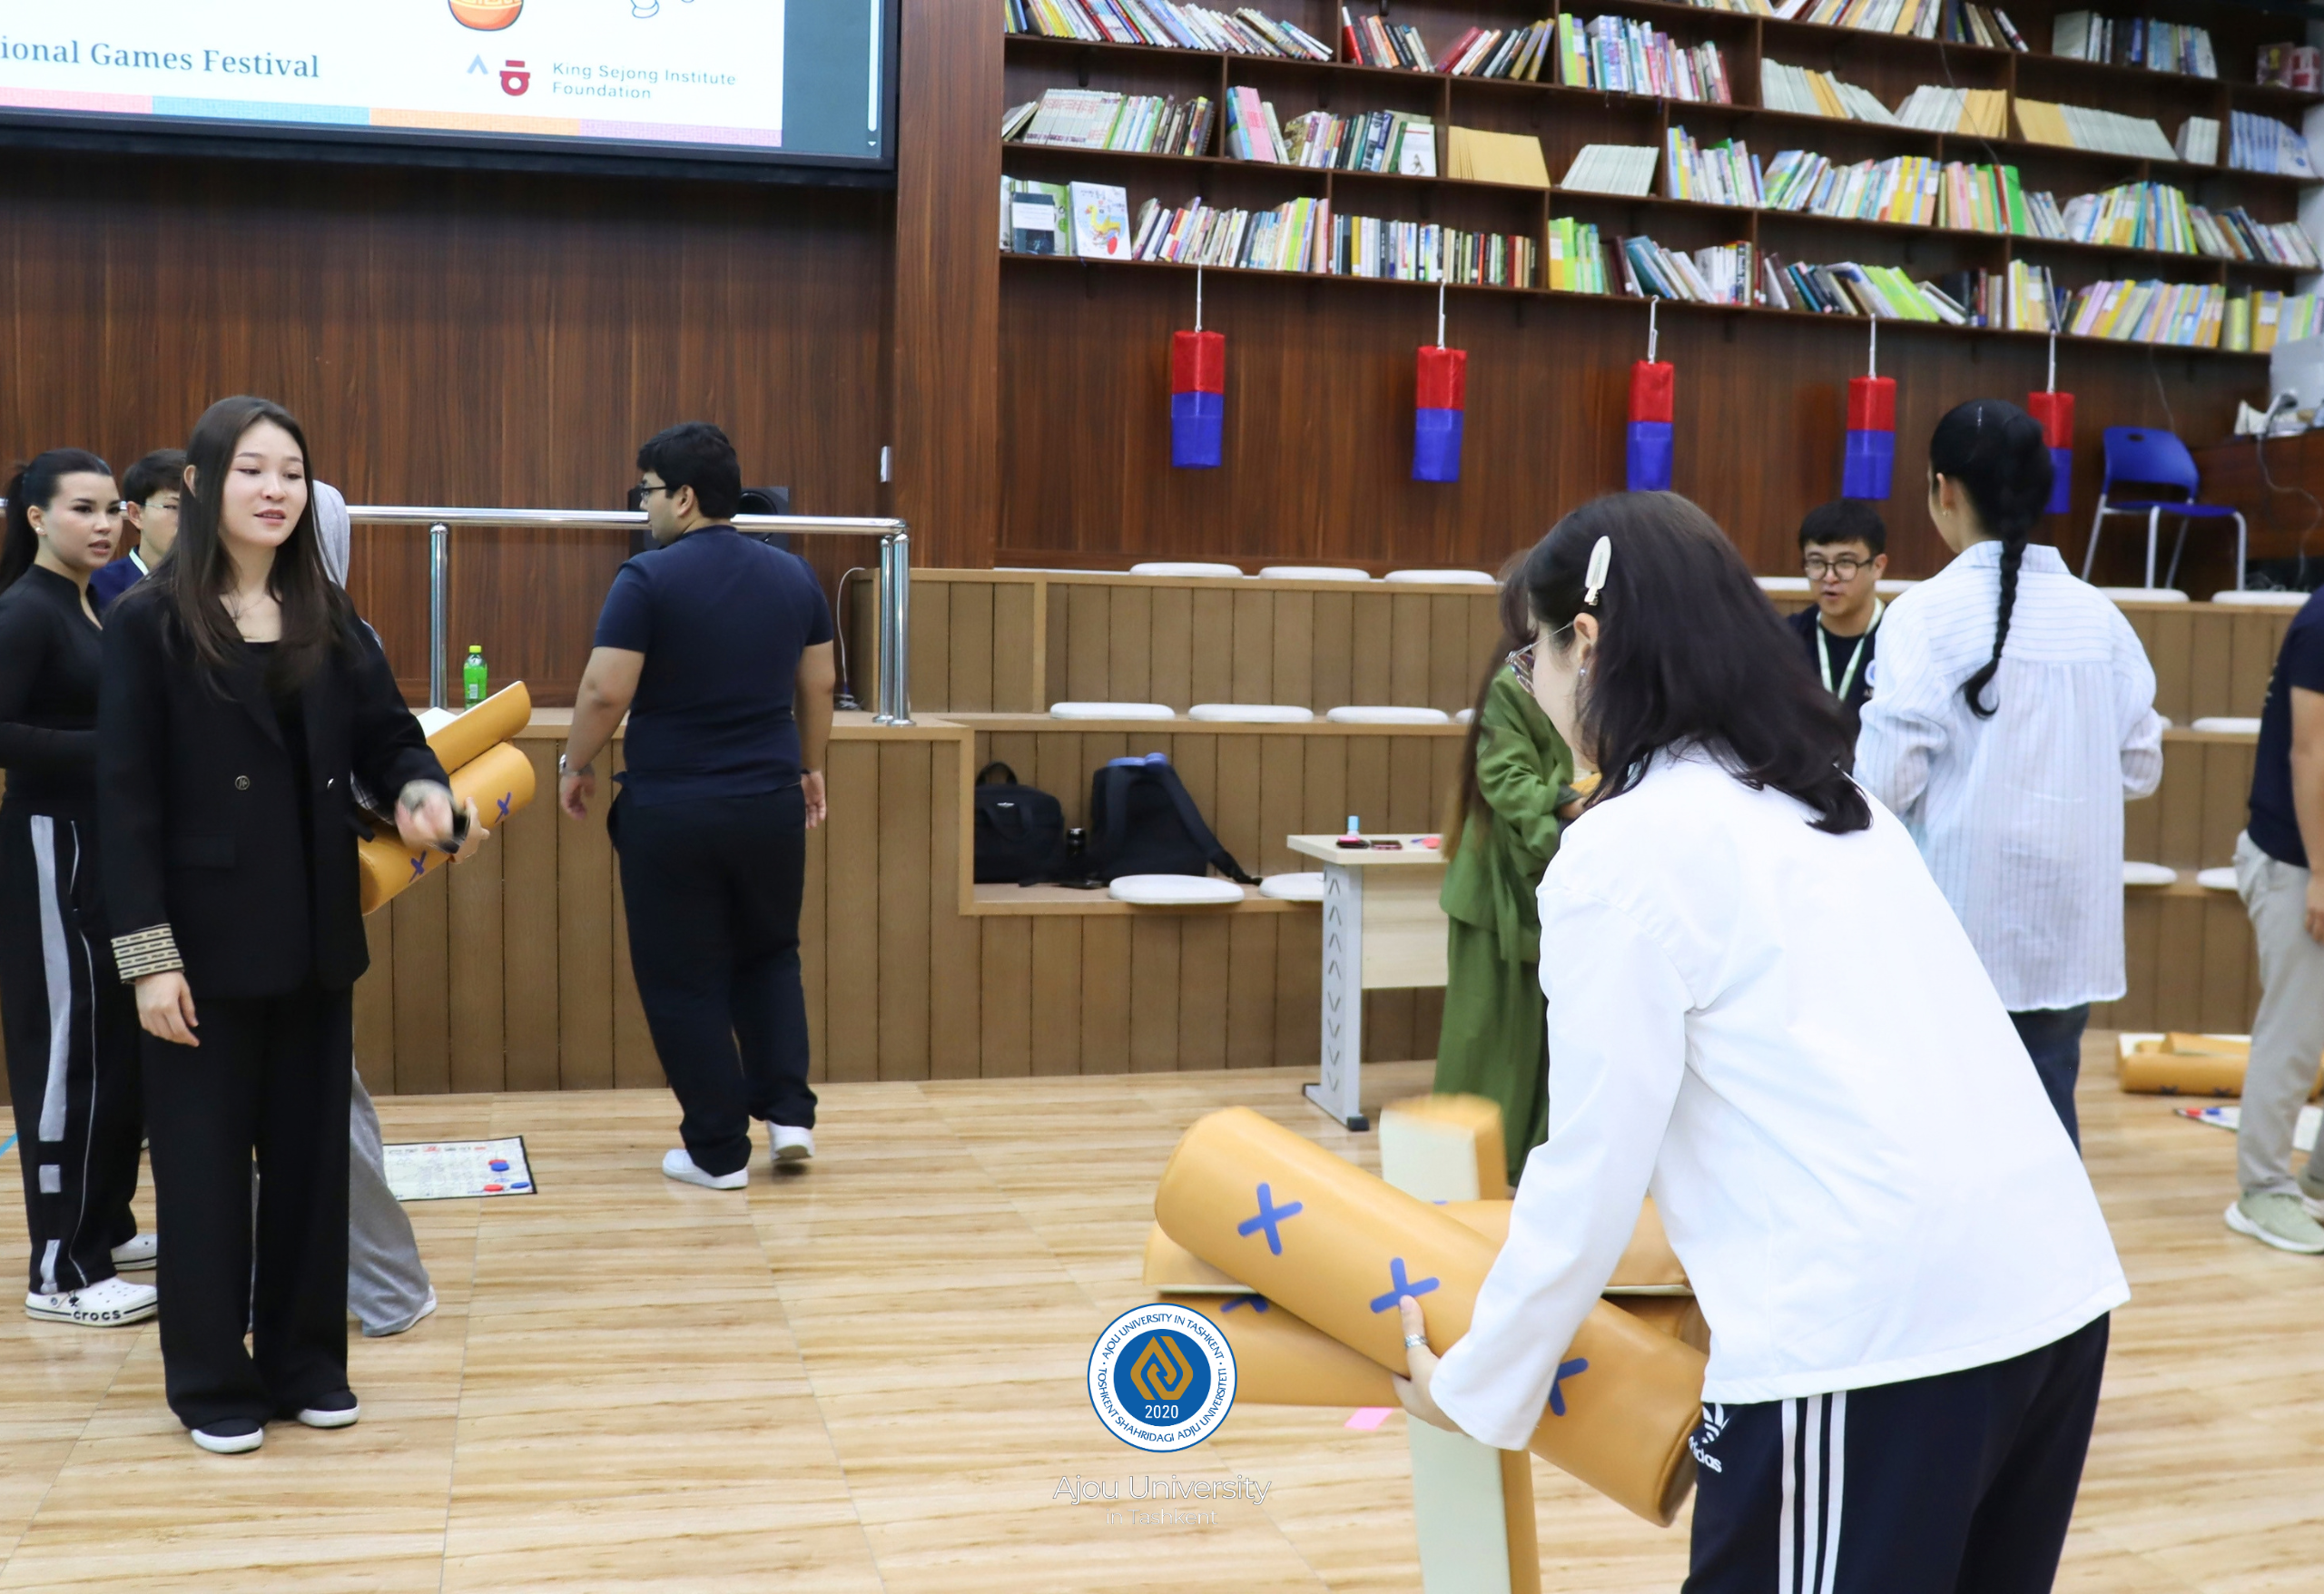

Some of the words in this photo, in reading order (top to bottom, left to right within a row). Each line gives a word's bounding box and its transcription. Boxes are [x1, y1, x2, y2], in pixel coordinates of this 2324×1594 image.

[2, 34, 80, 64] ional
[91, 43, 192, 71] Games
[203, 49, 320, 78] Festival
[553, 62, 592, 80] King
[599, 64, 658, 84] Sejong
[665, 69, 736, 85] Institute
[553, 82, 652, 99] Foundation
[73, 1310, 122, 1322] crocs
